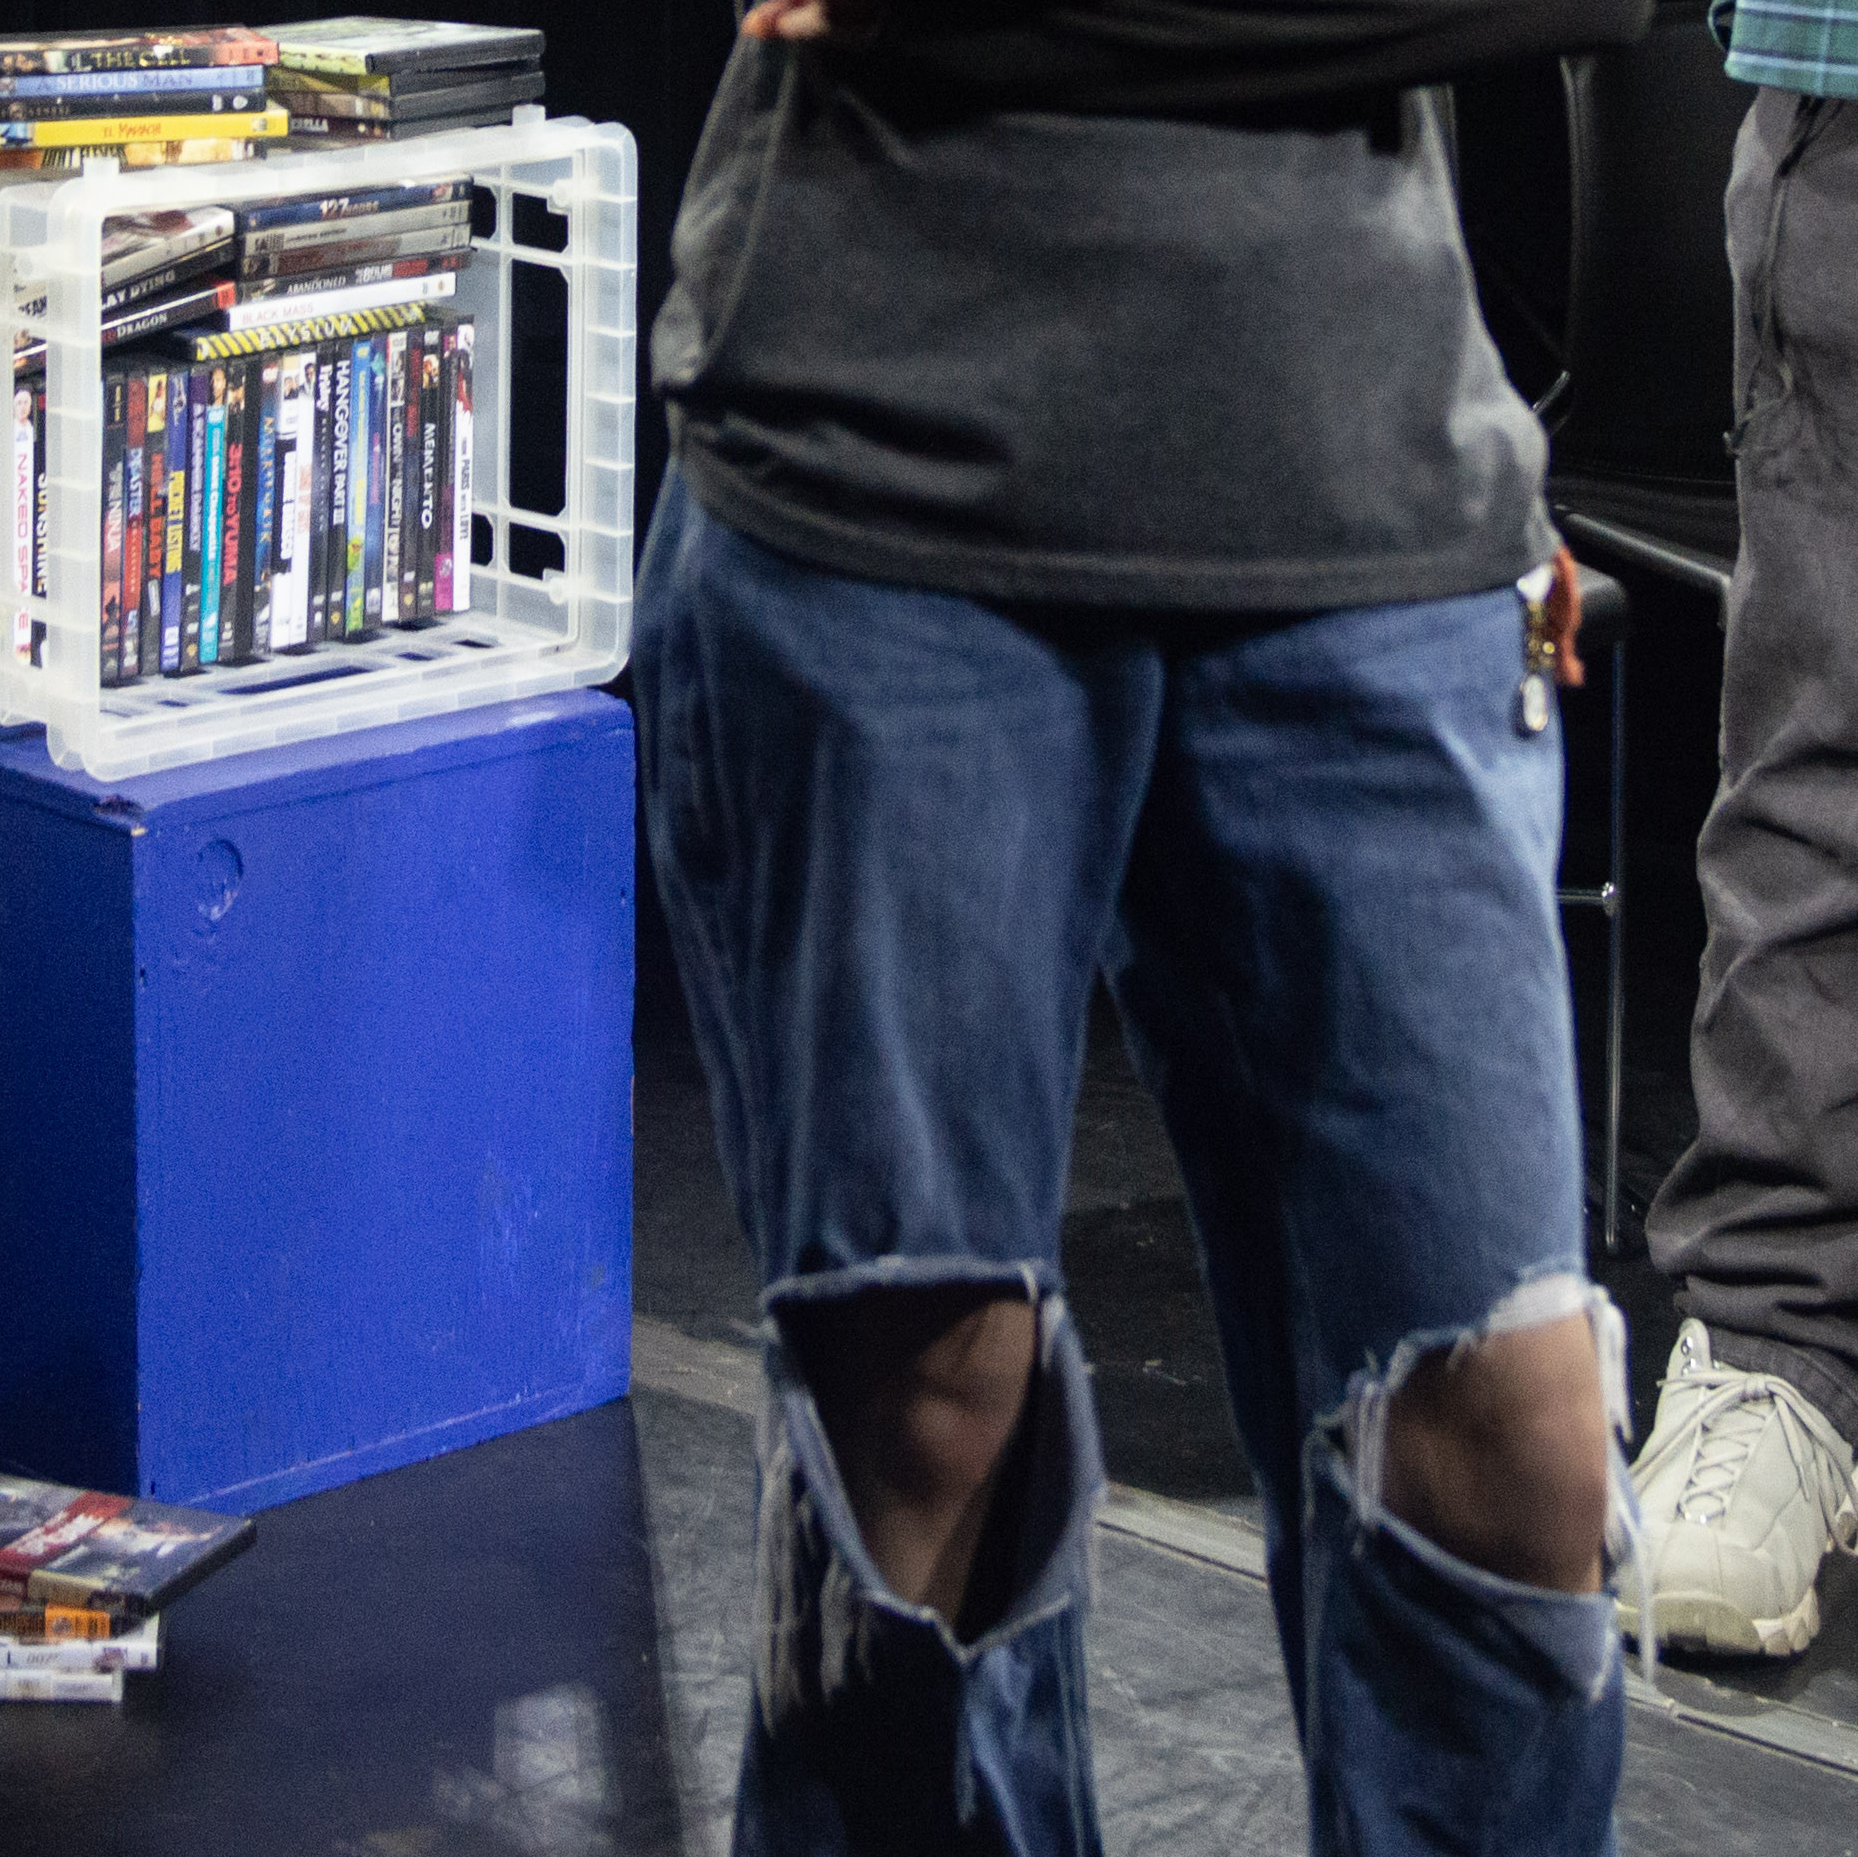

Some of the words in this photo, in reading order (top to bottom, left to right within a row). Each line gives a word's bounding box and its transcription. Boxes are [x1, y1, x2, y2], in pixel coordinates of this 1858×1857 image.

[55, 72, 140, 92] SERIOUS
[141, 71, 194, 89] MAN
[319, 197, 349, 221] 127
[117, 312, 168, 339] DRAGON
[282, 302, 314, 320] MASS
[259, 316, 354, 348] ELYSIUM
[333, 359, 351, 472] HANGOVER
[333, 474, 347, 506] PART
[420, 421, 437, 529] MEMENTO
[16, 453, 29, 539] NAKED
[223, 511, 240, 585] YUMA
[16, 544, 29, 630] SPAE
